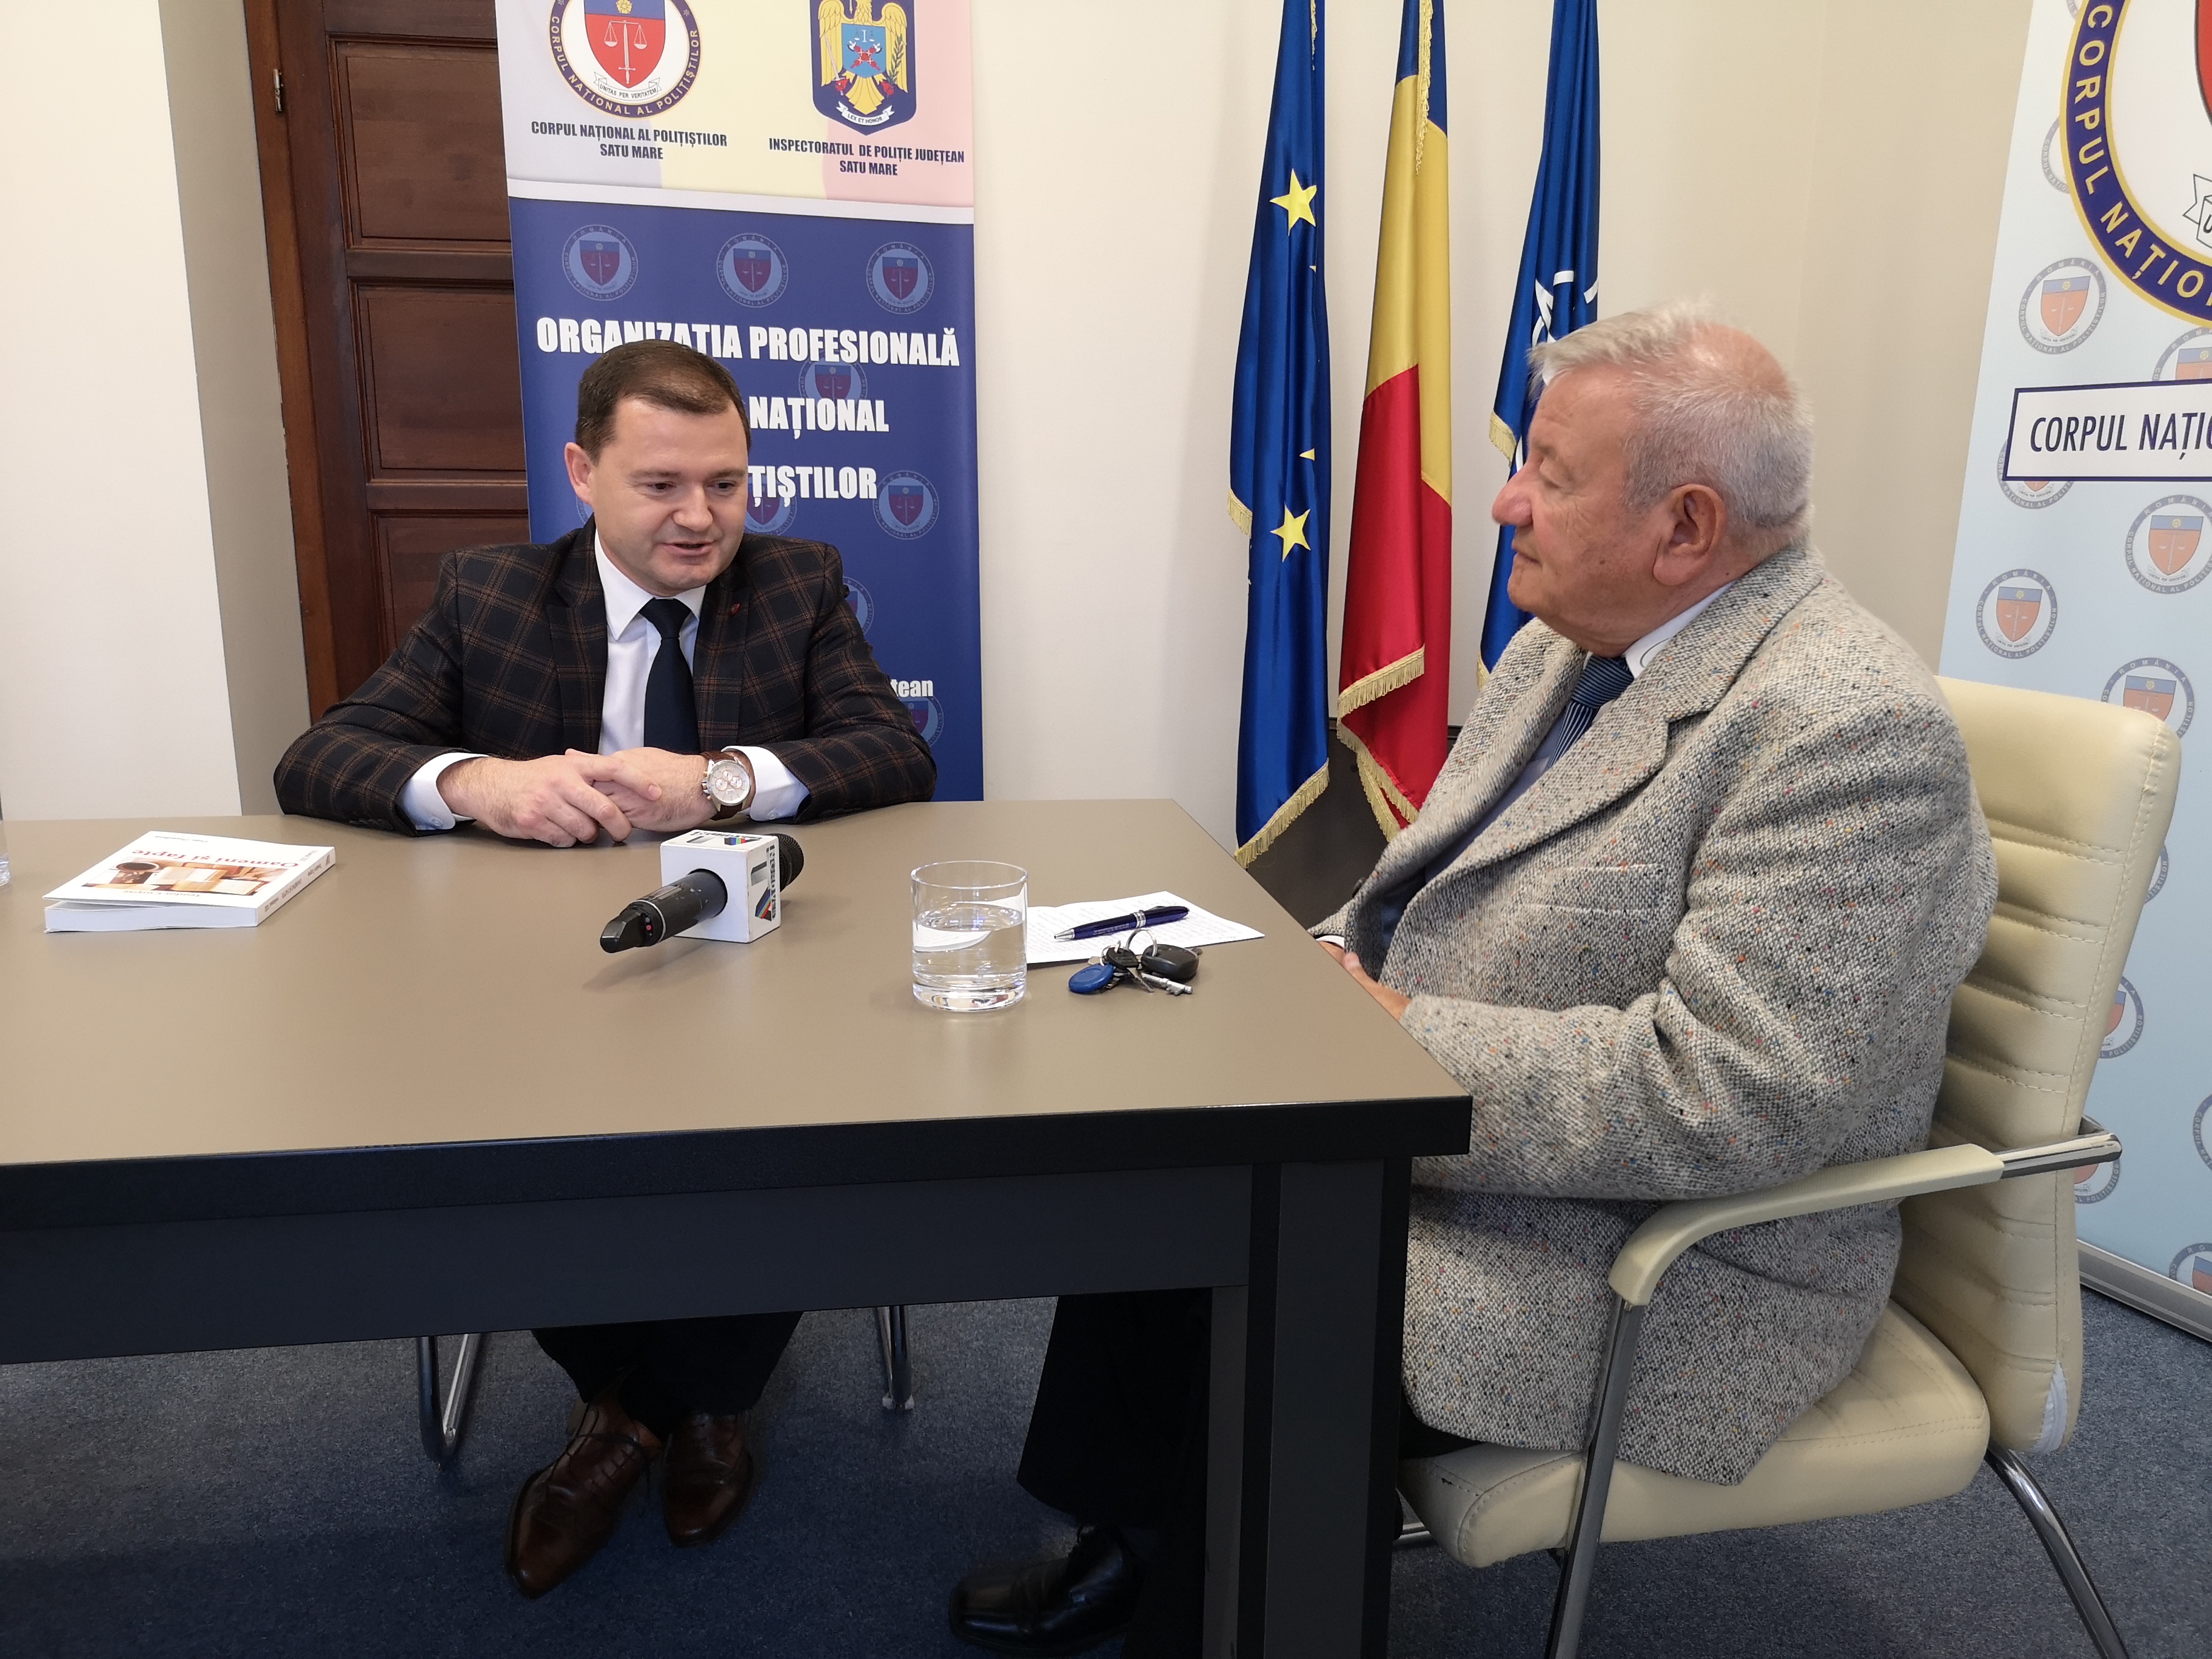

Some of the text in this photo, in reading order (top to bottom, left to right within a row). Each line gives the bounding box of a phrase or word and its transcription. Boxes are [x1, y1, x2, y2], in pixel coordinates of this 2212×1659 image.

[551, 16, 570, 72] CORPUL
[637, 106, 652, 115] AL
[600, 84, 617, 95] UNITAS
[631, 88, 657, 98] VERITATEM
[531, 121, 728, 147] CORPUL NAȚIONAL AL POLIȚIȘTILOR
[600, 143, 663, 159] SATU MARE
[769, 138, 964, 165] INSPECTORATUL DE POLIȚIE JUDEȚEAN
[2074, 5, 2113, 195] CORPUL
[2100, 201, 2212, 307] NAȚIO
[840, 160, 898, 176] SATU MARE
[749, 326, 960, 366] PROFESIONALĂ
[749, 396, 890, 440] NAȚIONAL
[2029, 415, 2128, 452] CORPUL
[748, 465, 877, 508] ȚIȘTILOR
[890, 679, 934, 697] tean
[132, 849, 187, 859] fapte
[215, 857, 299, 868] Oameni
